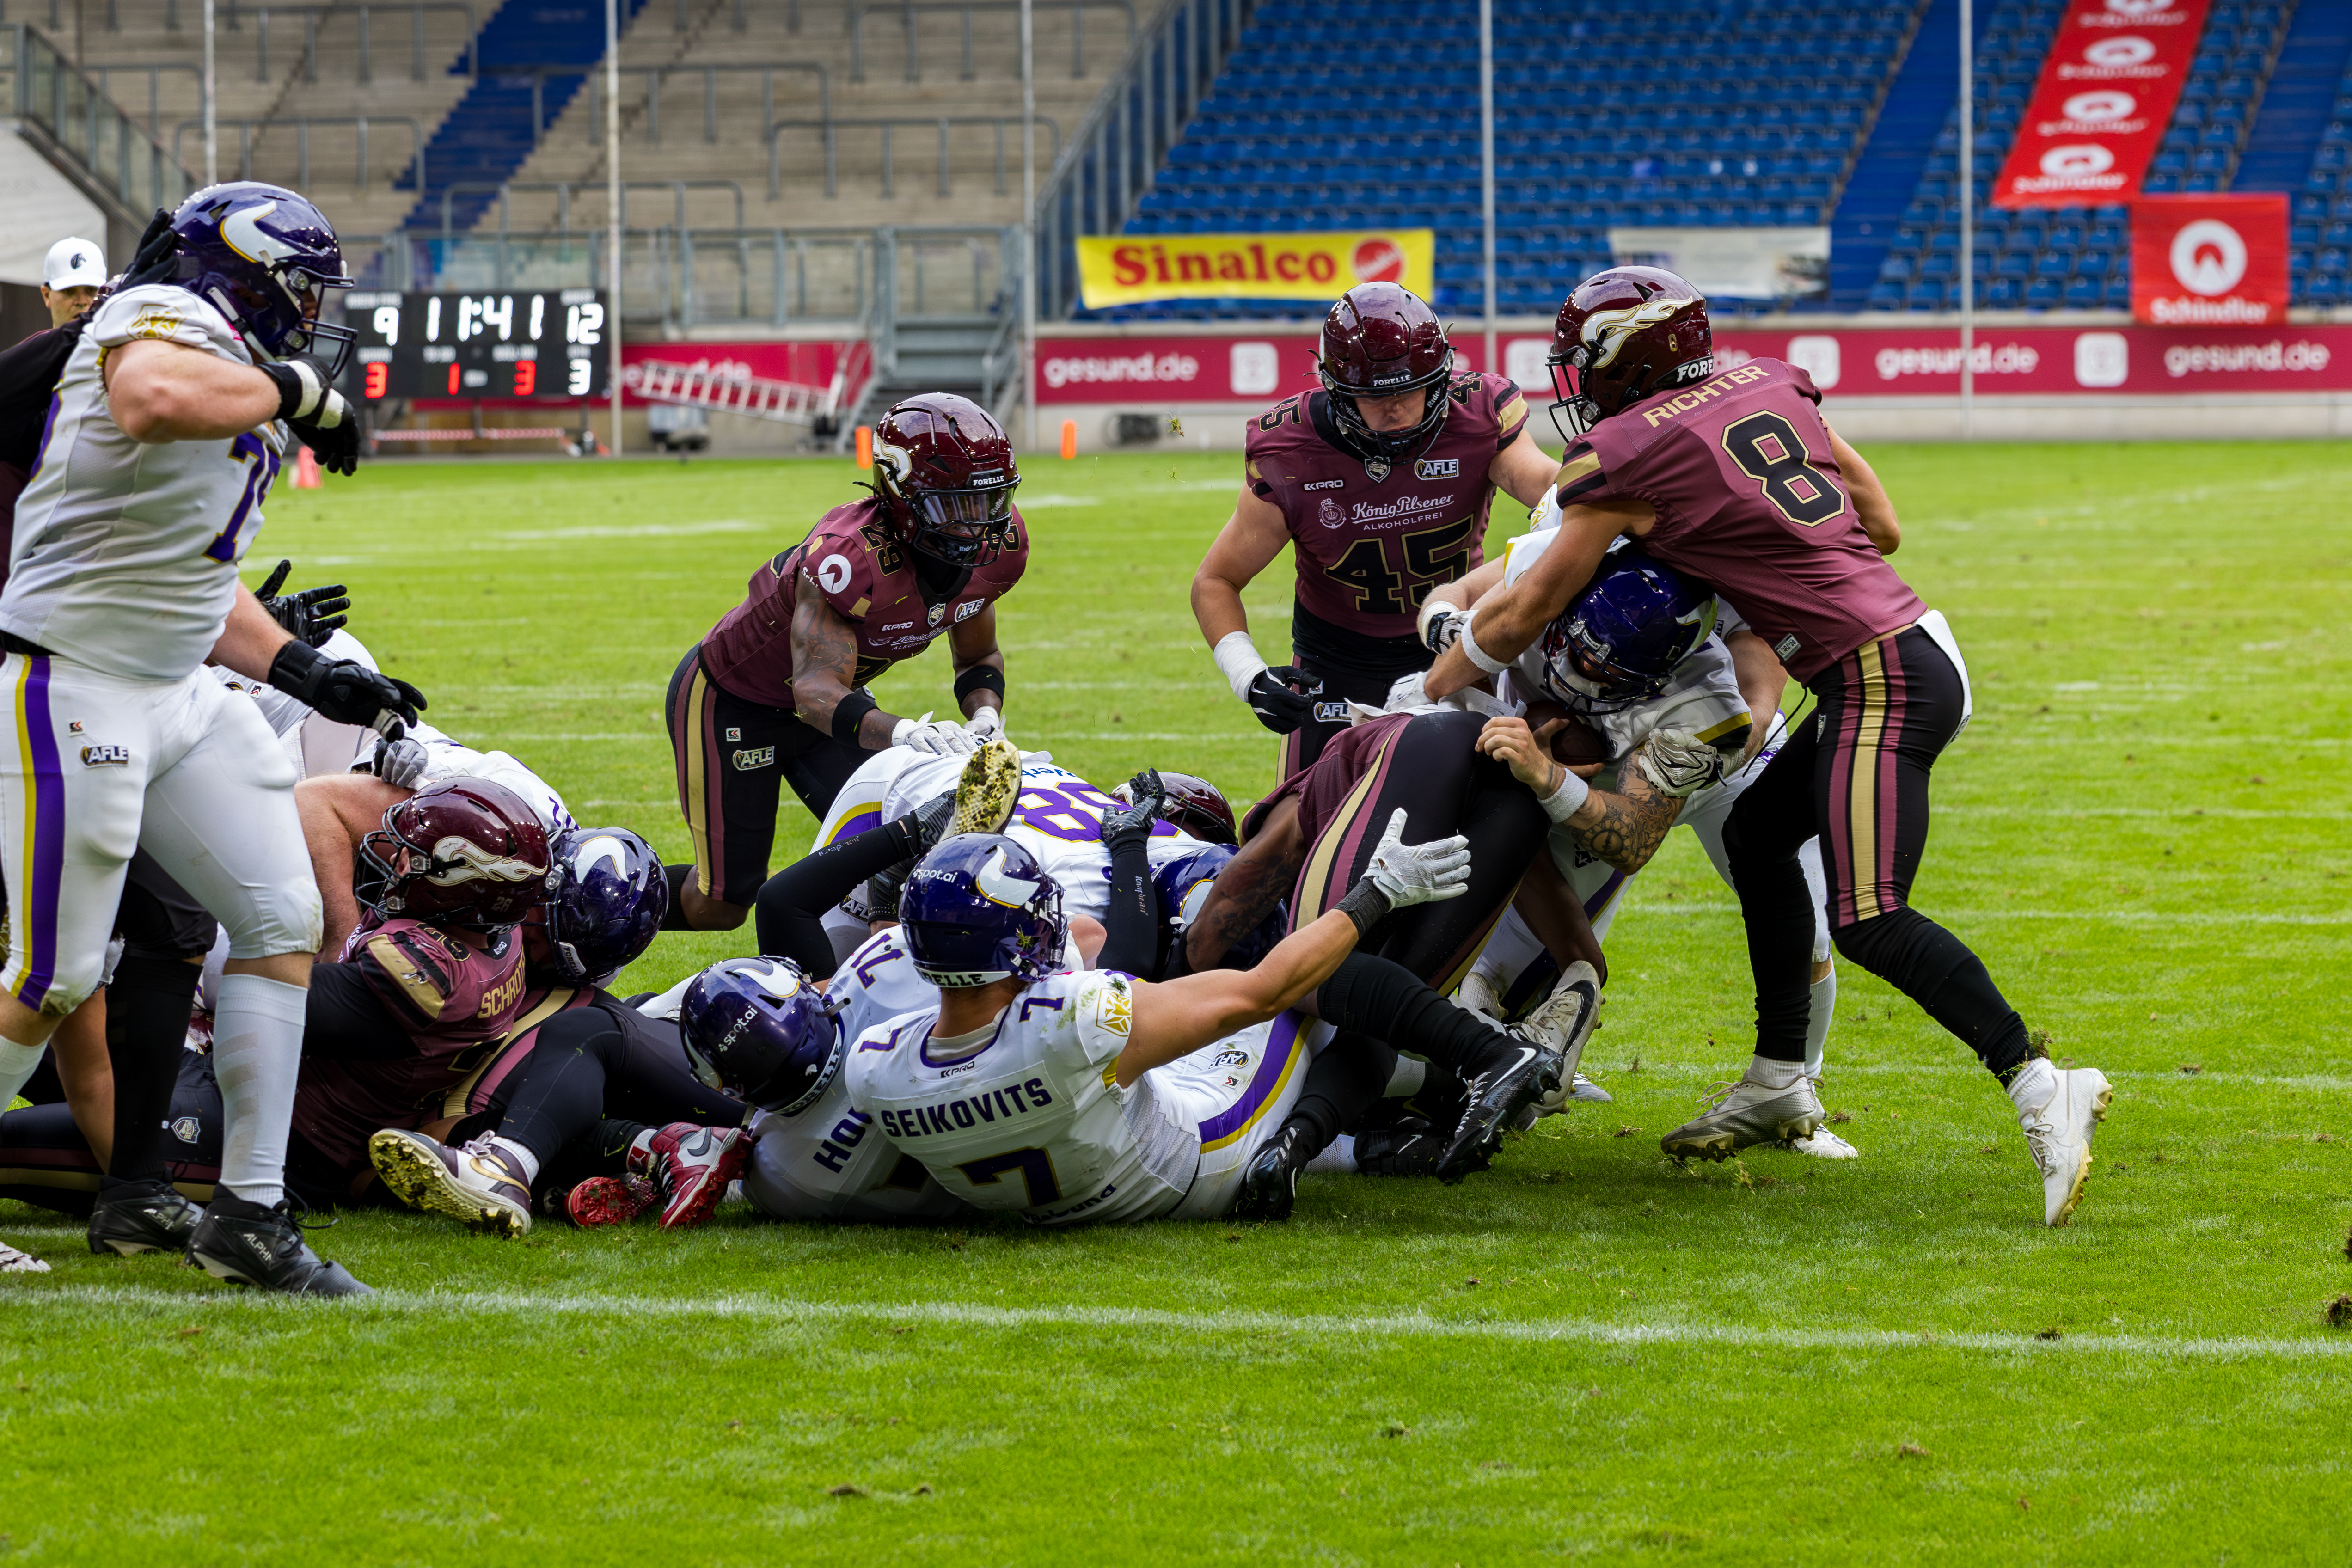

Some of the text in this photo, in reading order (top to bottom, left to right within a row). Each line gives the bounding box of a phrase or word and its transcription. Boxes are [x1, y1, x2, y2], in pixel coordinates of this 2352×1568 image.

[1112, 243, 1337, 286] Sinalco
[374, 306, 399, 346] 9
[426, 295, 545, 342] 11:41
[566, 303, 604, 345] 12
[568, 359, 592, 395] 3
[1043, 353, 1199, 387] gesund.de
[2163, 340, 2332, 378] gesund.de
[365, 362, 387, 398] 3
[448, 363, 460, 396] 1
[514, 360, 536, 396] 3
[1373, 374, 1411, 386] FORELLE
[1642, 366, 1770, 428] RICHTER
[973, 475, 1004, 486] FORELLE
[1421, 462, 1457, 476] AFLE
[1720, 409, 1845, 528] 8
[1351, 502, 1396, 520] König
[1396, 494, 1454, 514] Pilsener
[1364, 511, 1443, 530] ALKOHOLFREI
[859, 520, 905, 576] 29
[1323, 513, 1474, 615] 45
[958, 601, 983, 619] AFLE
[88, 747, 128, 763] AFLE
[741, 748, 772, 766] AFLE
[919, 869, 958, 883] spot.ai
[723, 1005, 758, 1046] spot.ai
[1019, 996, 1065, 1023] 7
[858, 1027, 904, 1055] 7
[881, 1078, 1052, 1138] SEIKOVITS
[954, 1146, 1064, 1207] 7
